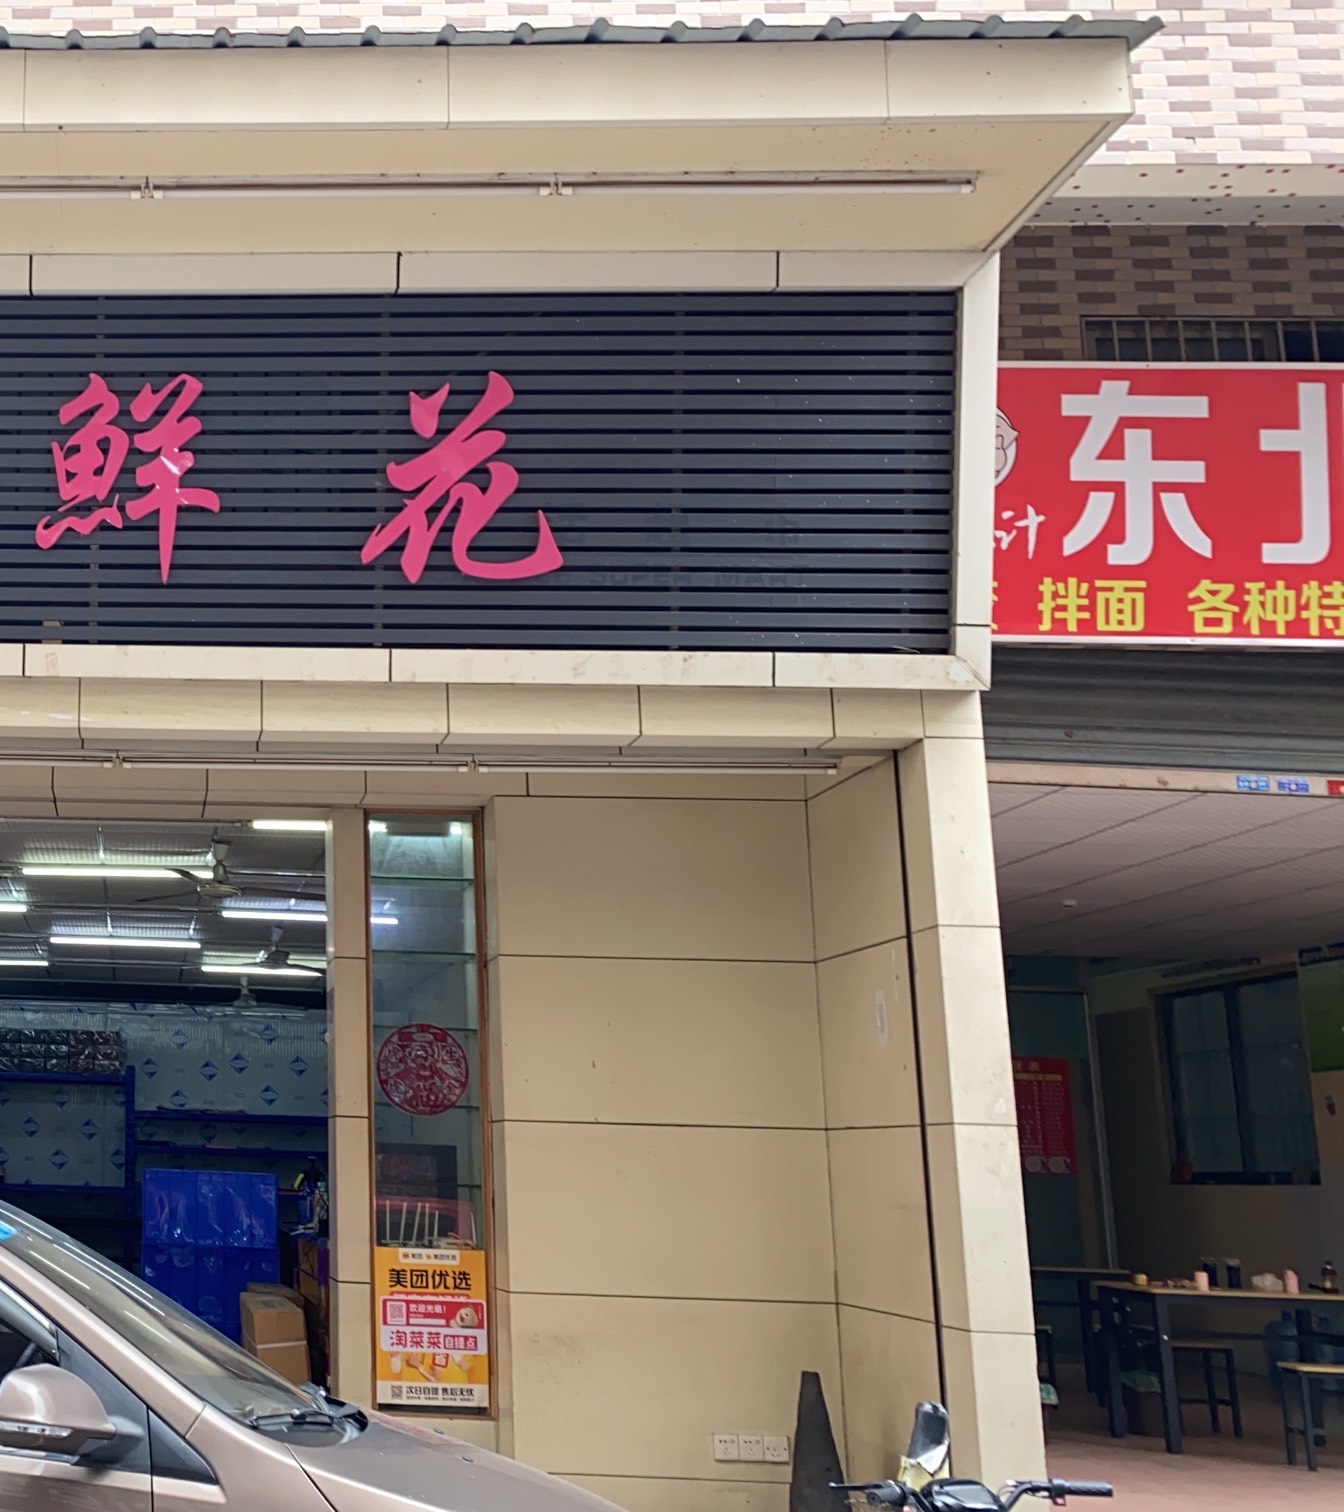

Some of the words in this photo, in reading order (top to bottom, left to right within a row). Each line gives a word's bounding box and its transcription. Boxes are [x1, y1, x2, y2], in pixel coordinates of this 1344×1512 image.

[1037, 576, 1148, 633] 拌面
[388, 1268, 472, 1291] 美团优选
[389, 1329, 442, 1349] 淘菜菜
